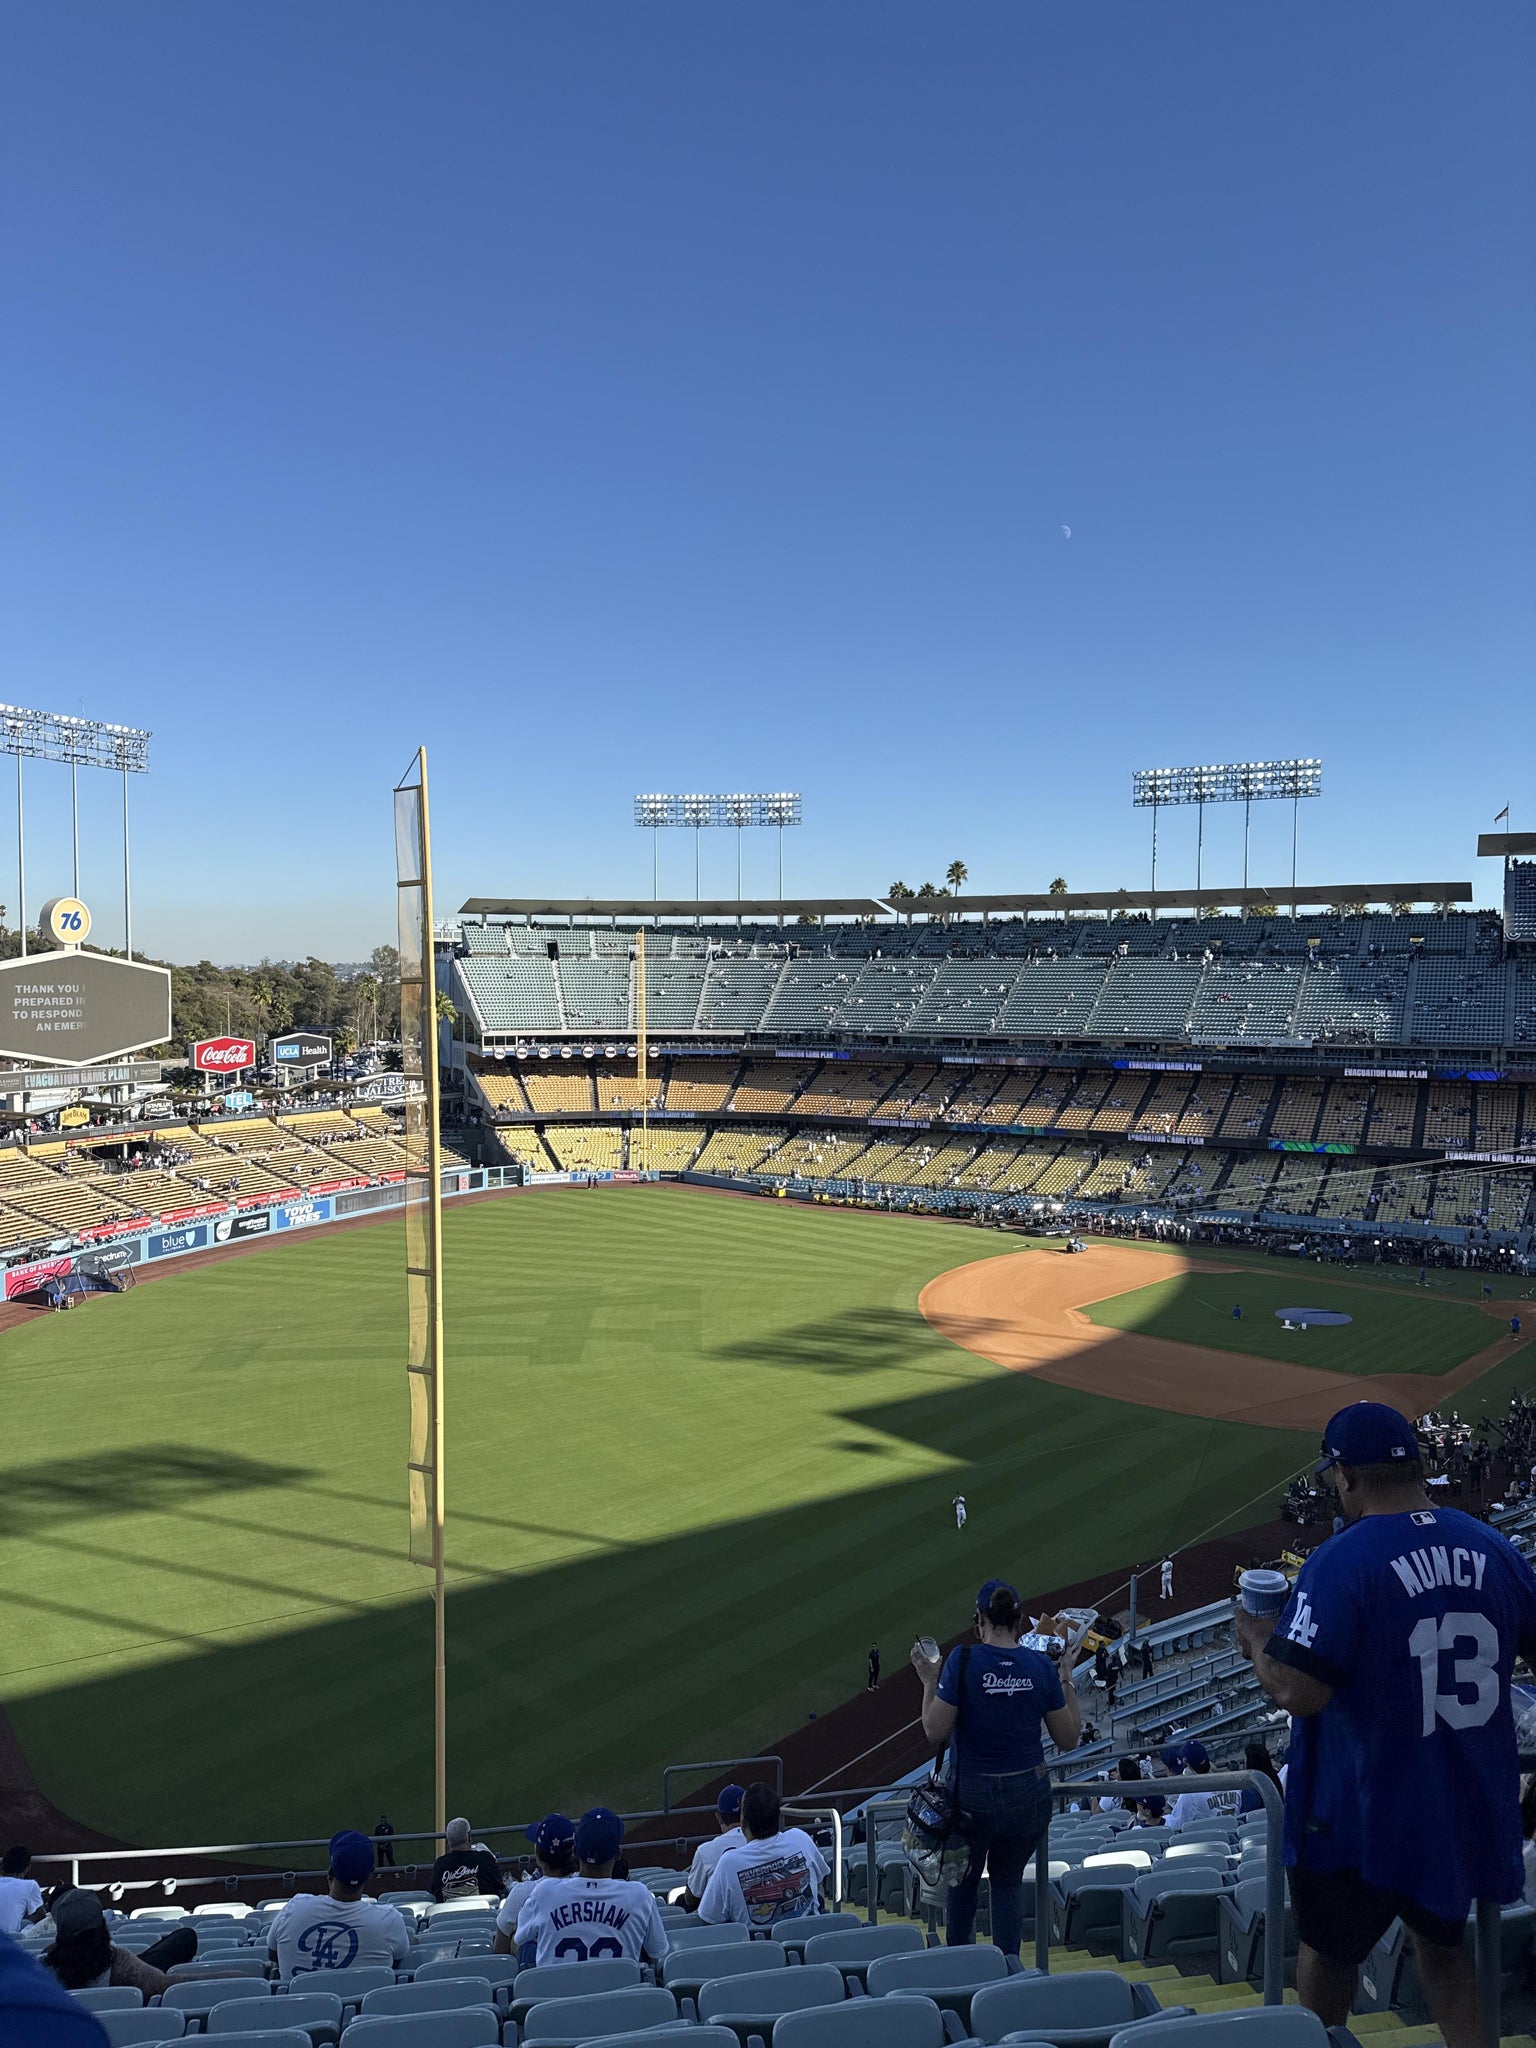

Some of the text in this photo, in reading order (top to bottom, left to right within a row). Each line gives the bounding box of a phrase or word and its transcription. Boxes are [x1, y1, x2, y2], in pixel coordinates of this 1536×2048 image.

[61, 911, 82, 930] 76
[15, 985, 54, 993] THANK
[57, 984, 79, 993] YOU
[14, 997, 73, 1006] PREPARED
[12, 1009, 82, 1019] TO RESPOND
[36, 1022, 52, 1031] AN
[201, 1045, 250, 1065] Coca-Cola
[280, 1045, 327, 1056] UCLA Health
[1129, 1061, 1202, 1071] EVACUATION GAME PLAN
[1345, 1068, 1427, 1078] EVACUATION GAME PLAN
[25, 1072, 80, 1088] EVACUATION
[81, 1070, 106, 1084] GAME
[108, 1068, 130, 1081] PLAN
[62, 1109, 87, 1123] JIM BEAM
[1187, 1136, 1204, 1144] PLAN
[1445, 1151, 1490, 1161] EVACUATION
[1492, 1152, 1514, 1162] GAME
[284, 1204, 314, 1218] TOYO
[289, 1211, 321, 1226] TIRES
[162, 1235, 185, 1249] blue
[94, 1250, 128, 1264] Spectrum
[12, 1268, 28, 1278] BANK
[29, 1265, 37, 1273] OF
[1390, 1546, 1486, 1598] MUNCY
[1287, 1592, 1319, 1649] LA
[1408, 1612, 1500, 1737] 13
[983, 1672, 1034, 1696] Dodgers
[1207, 1792, 1236, 1809] OHTANI
[550, 1901, 630, 1931] KERSHAW
